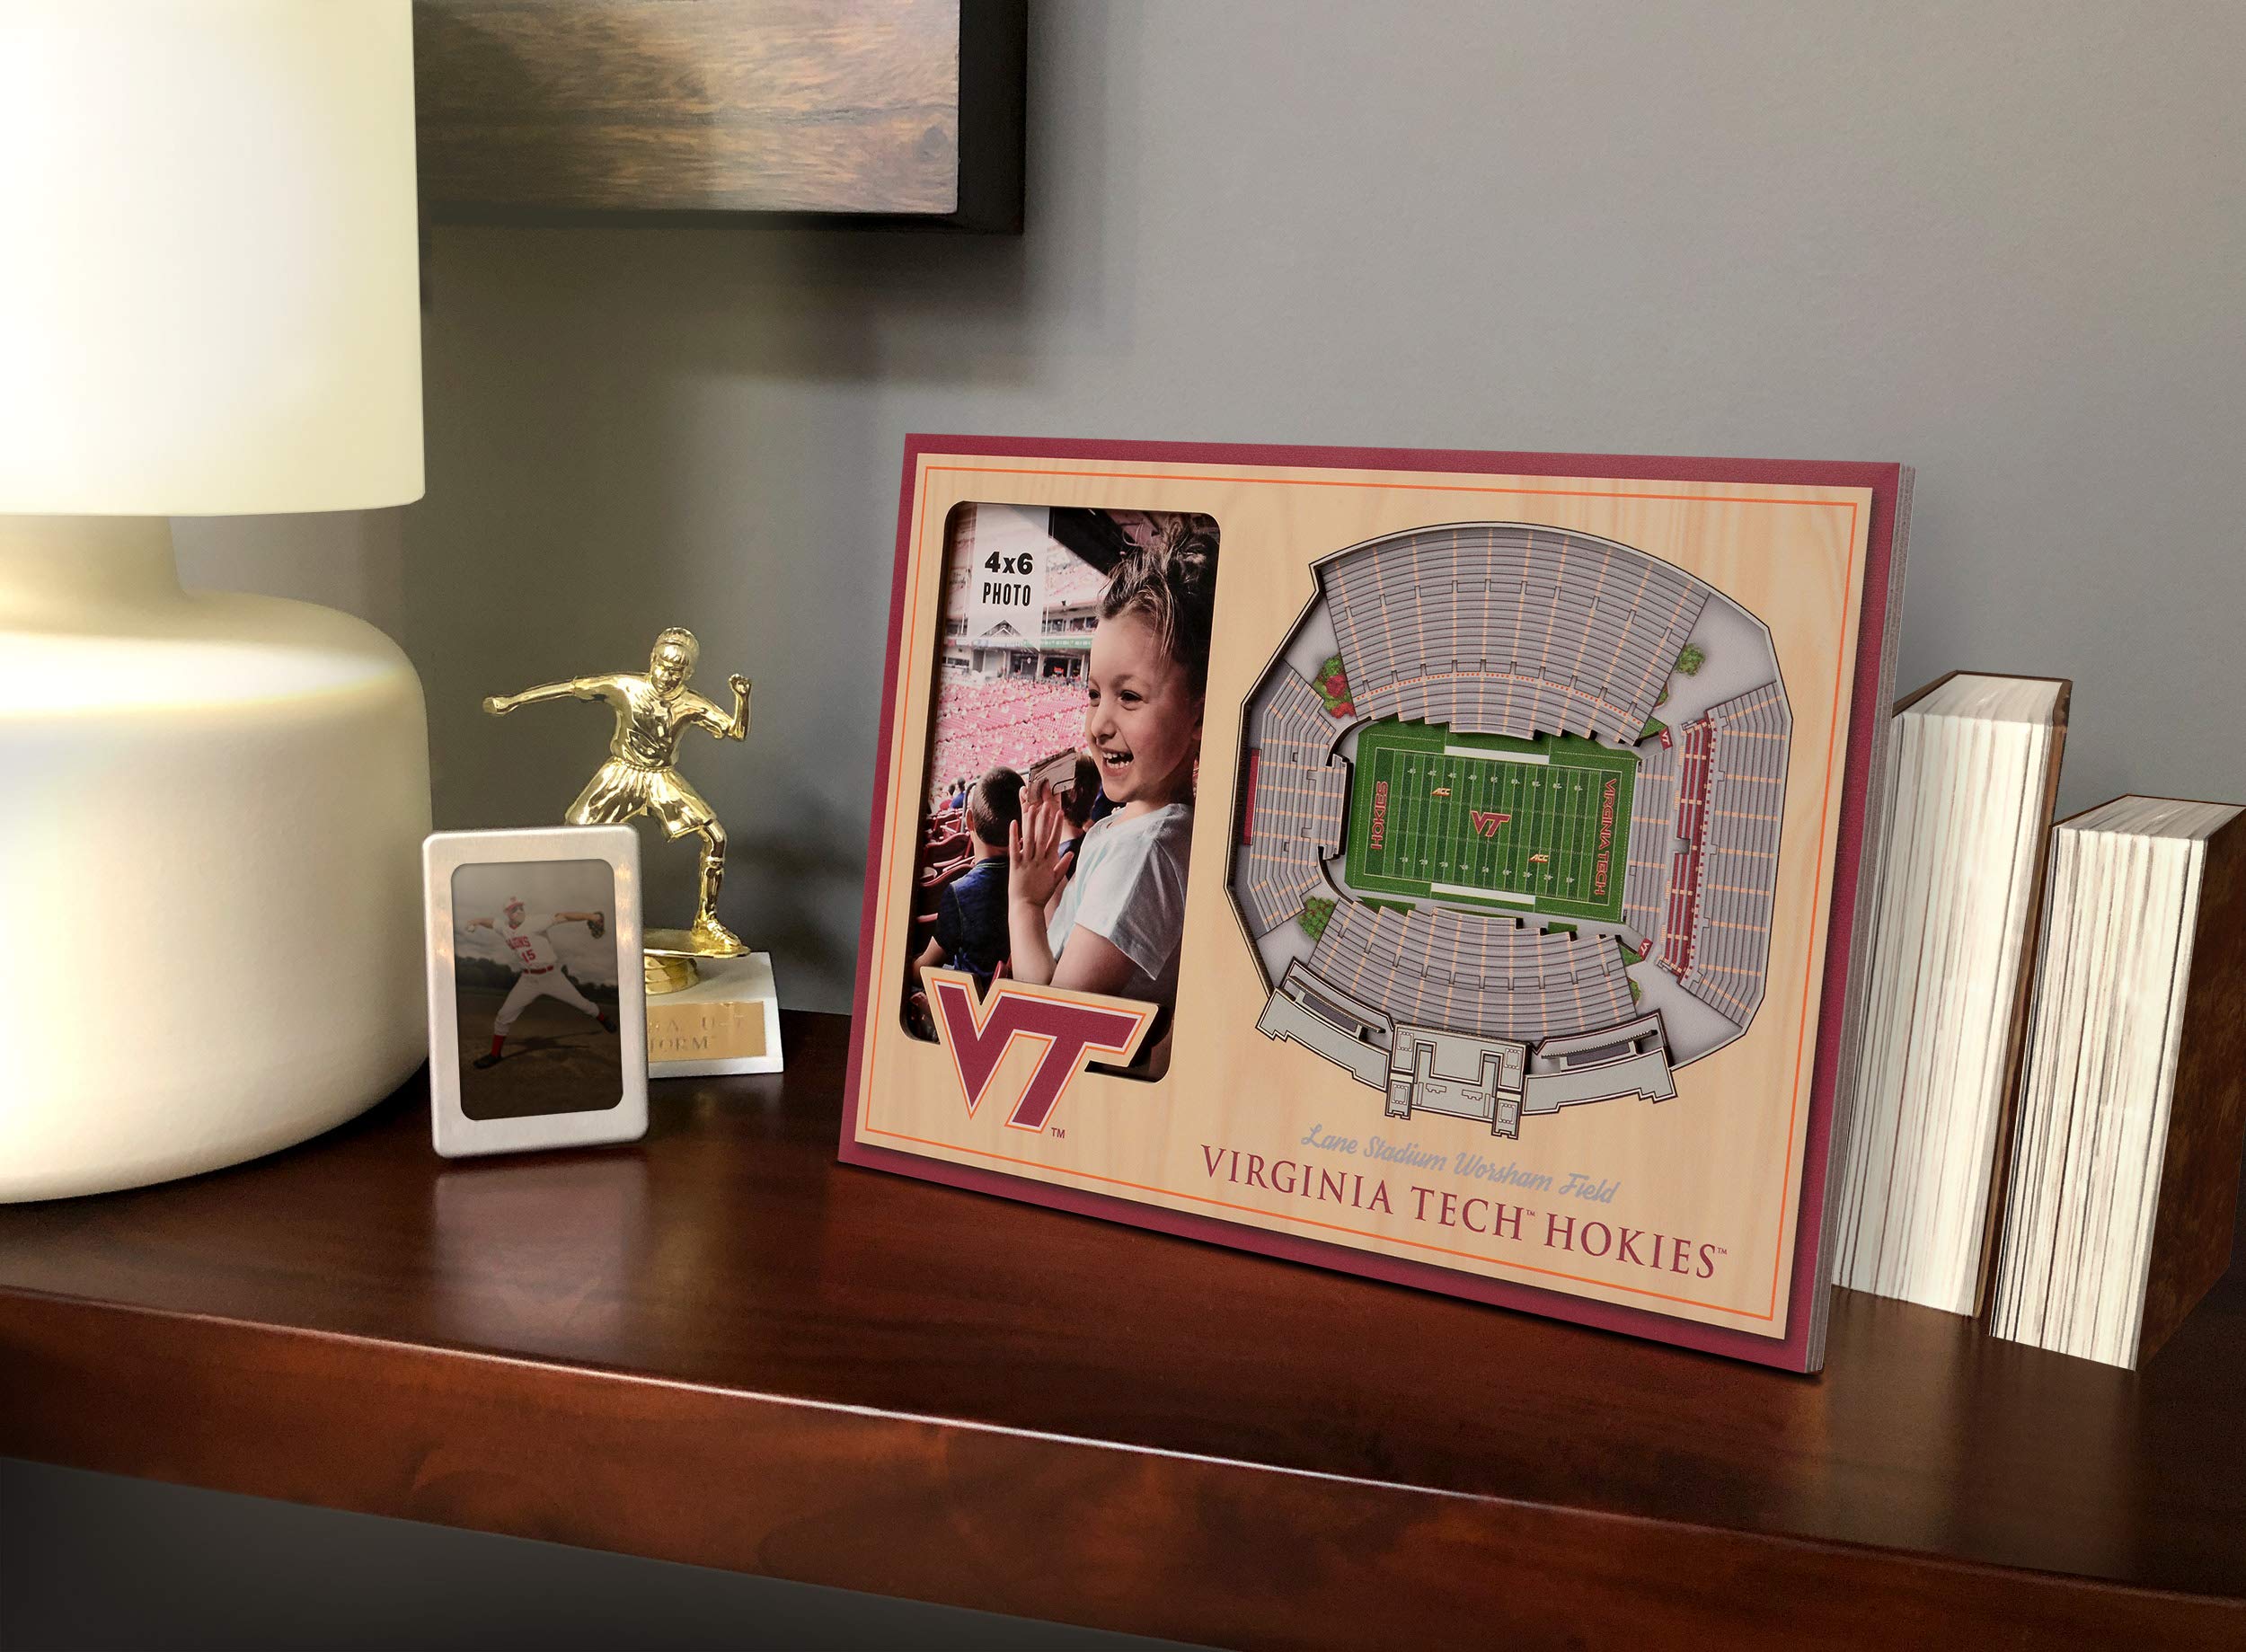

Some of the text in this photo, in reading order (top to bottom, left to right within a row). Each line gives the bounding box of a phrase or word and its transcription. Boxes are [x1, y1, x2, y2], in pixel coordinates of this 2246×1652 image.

[984, 551, 1033, 576] 4x6
[982, 581, 1031, 607] PHOTO
[1370, 781, 1388, 850] HOKIES
[1471, 810, 1511, 838] VT
[1594, 778, 1617, 896] VIRGINIA TECH
[1529, 853, 1549, 863] ACC
[522, 949, 536, 965] 15
[931, 977, 1146, 1134] VT
[1200, 1144, 1394, 1215] VIRGINIA
[1301, 1124, 1622, 1204] Lane Stadium Worsham Field
